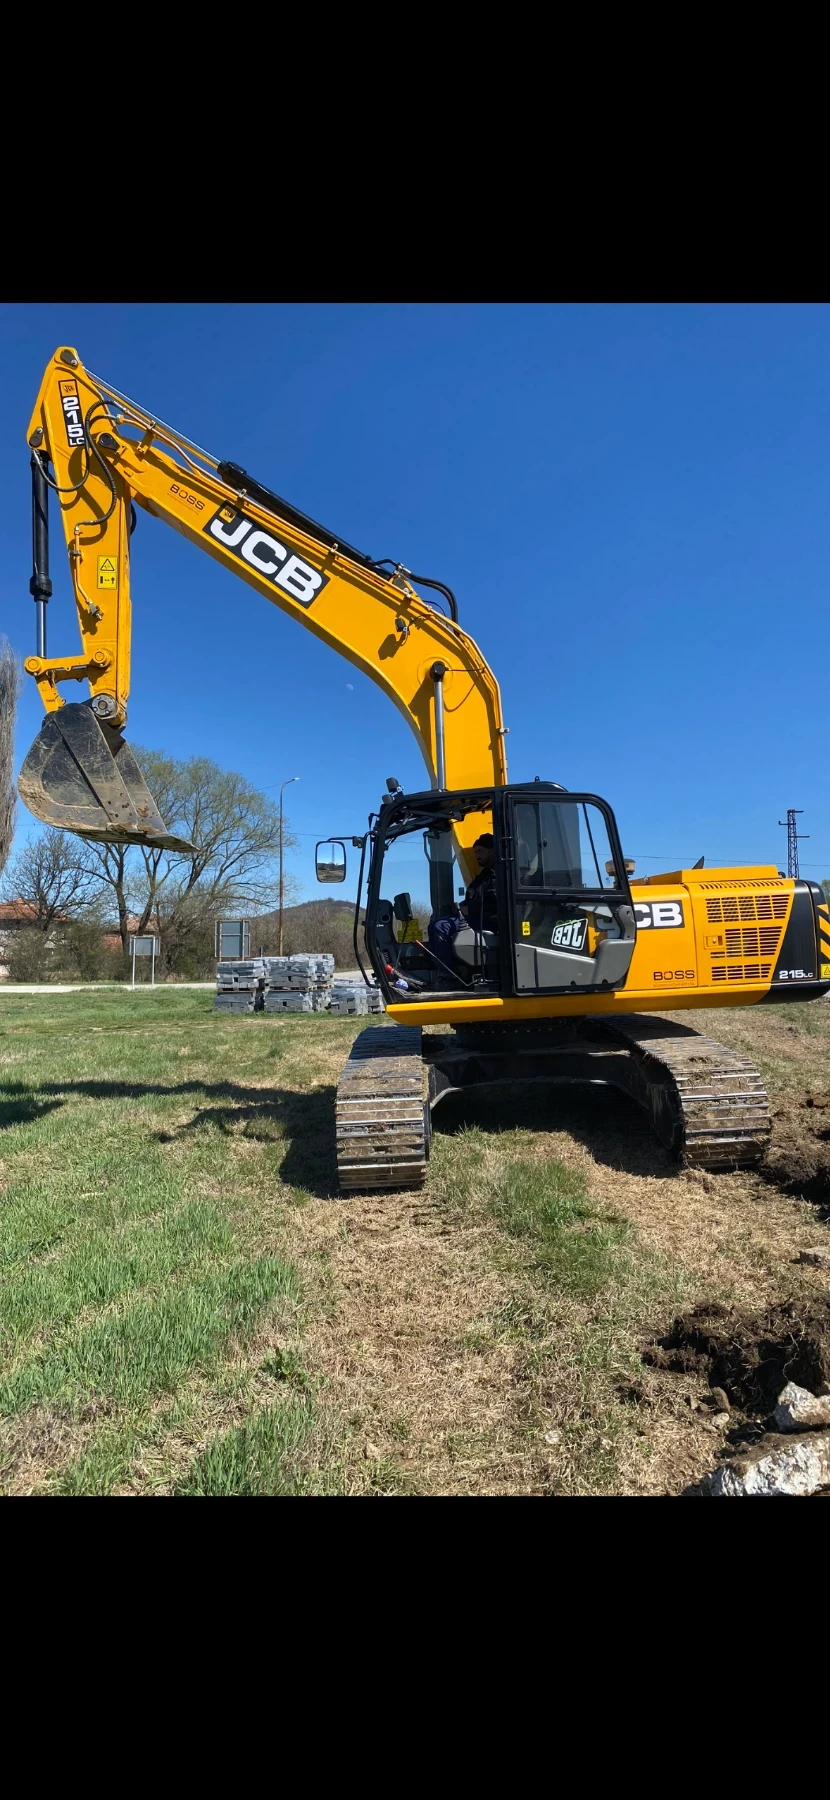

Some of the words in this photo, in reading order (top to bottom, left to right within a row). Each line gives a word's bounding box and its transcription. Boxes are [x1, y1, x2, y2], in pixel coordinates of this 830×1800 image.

[170, 484, 205, 510] BOSS
[210, 518, 322, 602] JCB
[653, 969, 695, 981] BOSS
